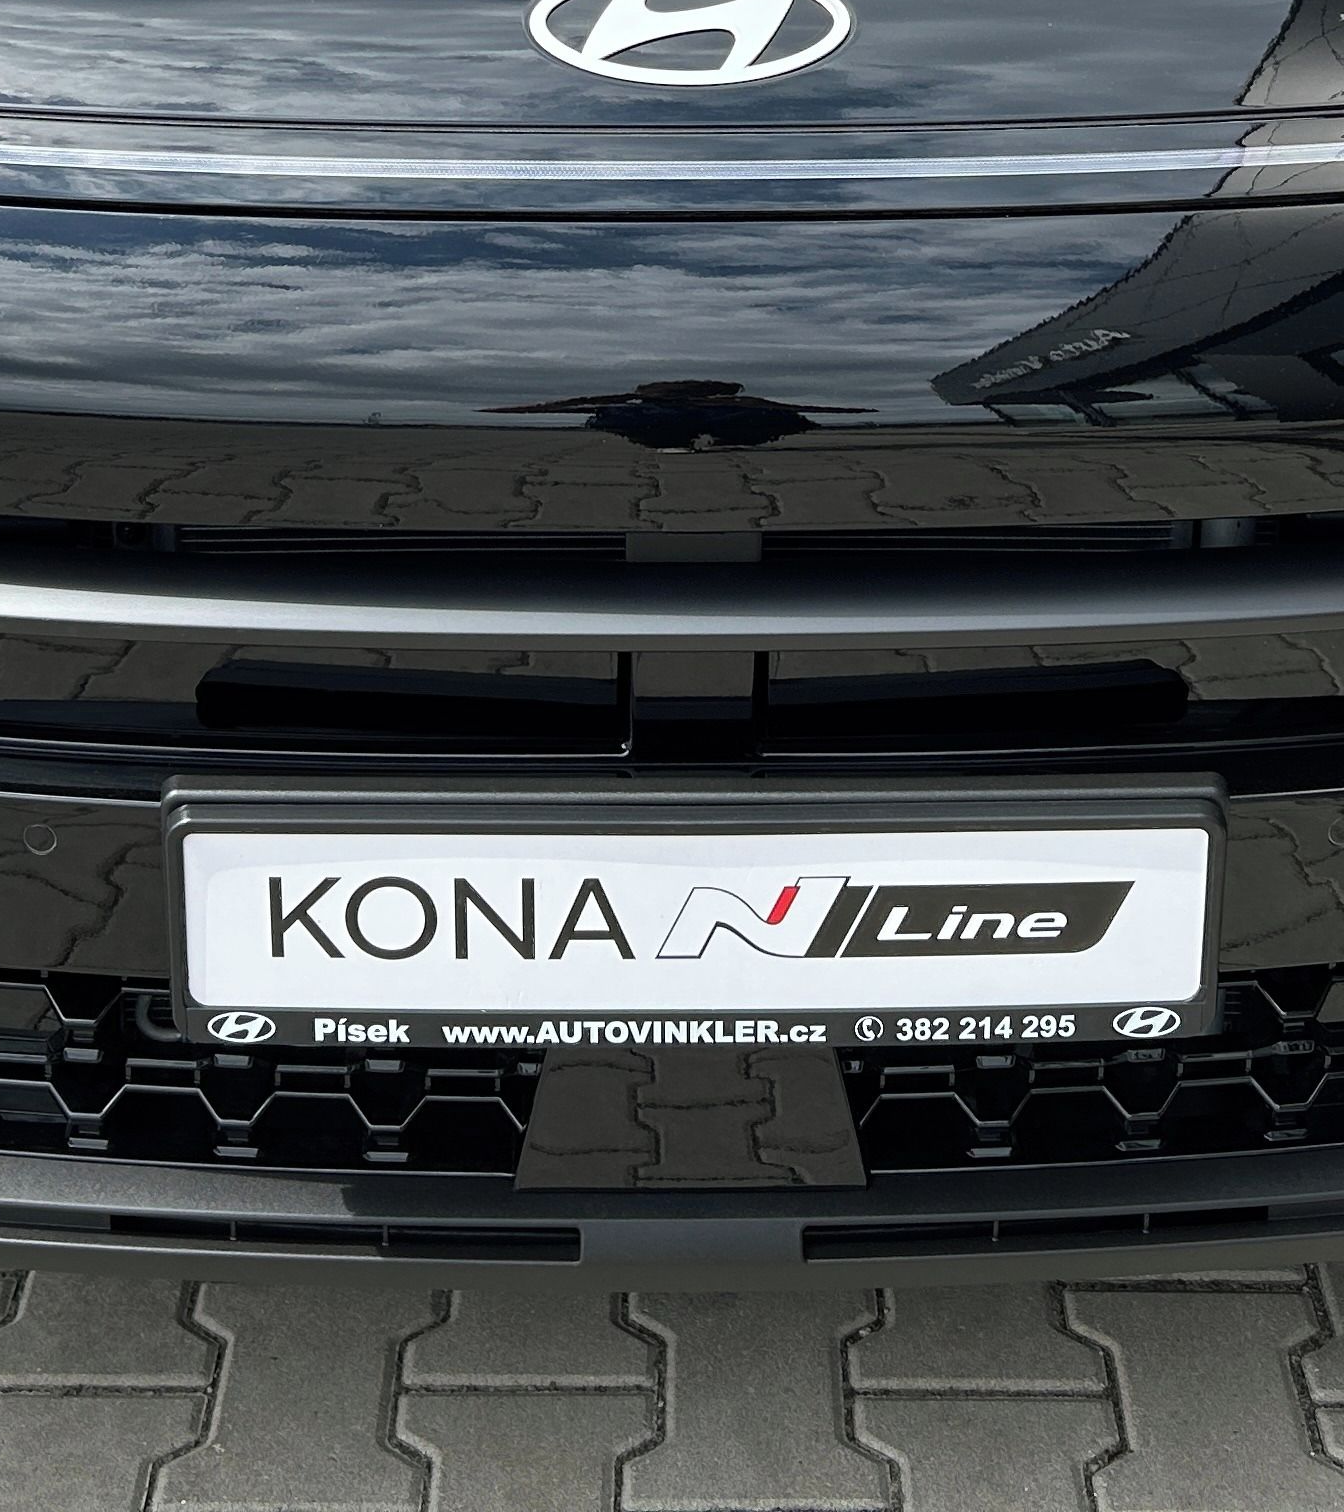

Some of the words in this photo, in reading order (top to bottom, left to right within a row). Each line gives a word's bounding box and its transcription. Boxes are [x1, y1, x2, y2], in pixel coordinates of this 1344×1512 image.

[268, 875, 637, 961] KONA
[875, 904, 1068, 942] Line
[314, 1017, 411, 1044] Písek
[441, 1019, 827, 1045] www.AUTOVINKLER.cz
[895, 1017, 950, 1042] 382
[958, 1016, 1013, 1040] 214
[1022, 1014, 1076, 1039] 295
